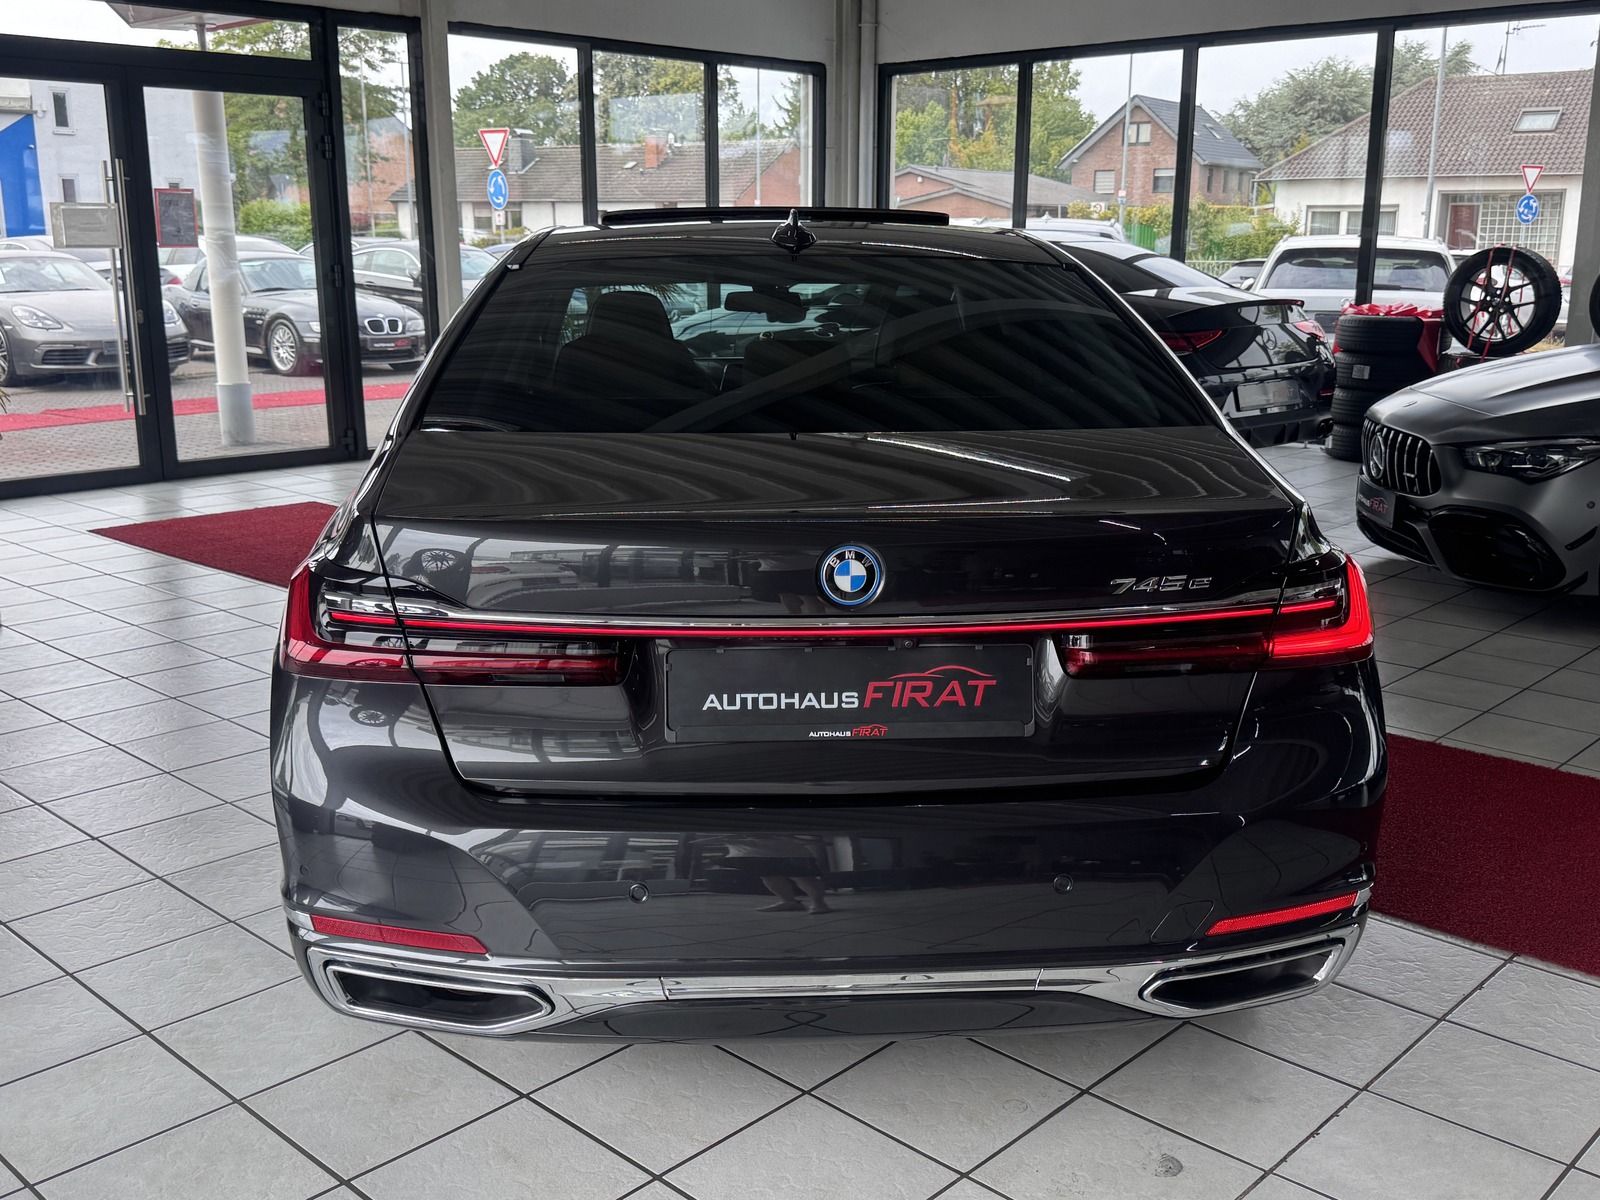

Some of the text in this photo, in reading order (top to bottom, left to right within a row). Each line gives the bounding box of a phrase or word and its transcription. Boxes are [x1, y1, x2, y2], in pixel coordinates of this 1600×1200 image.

[829, 550, 872, 568] BMW
[1110, 574, 1212, 594] 745e
[702, 680, 997, 711] AUTOHAUS FIRAT
[851, 728, 888, 737] FIRAT
